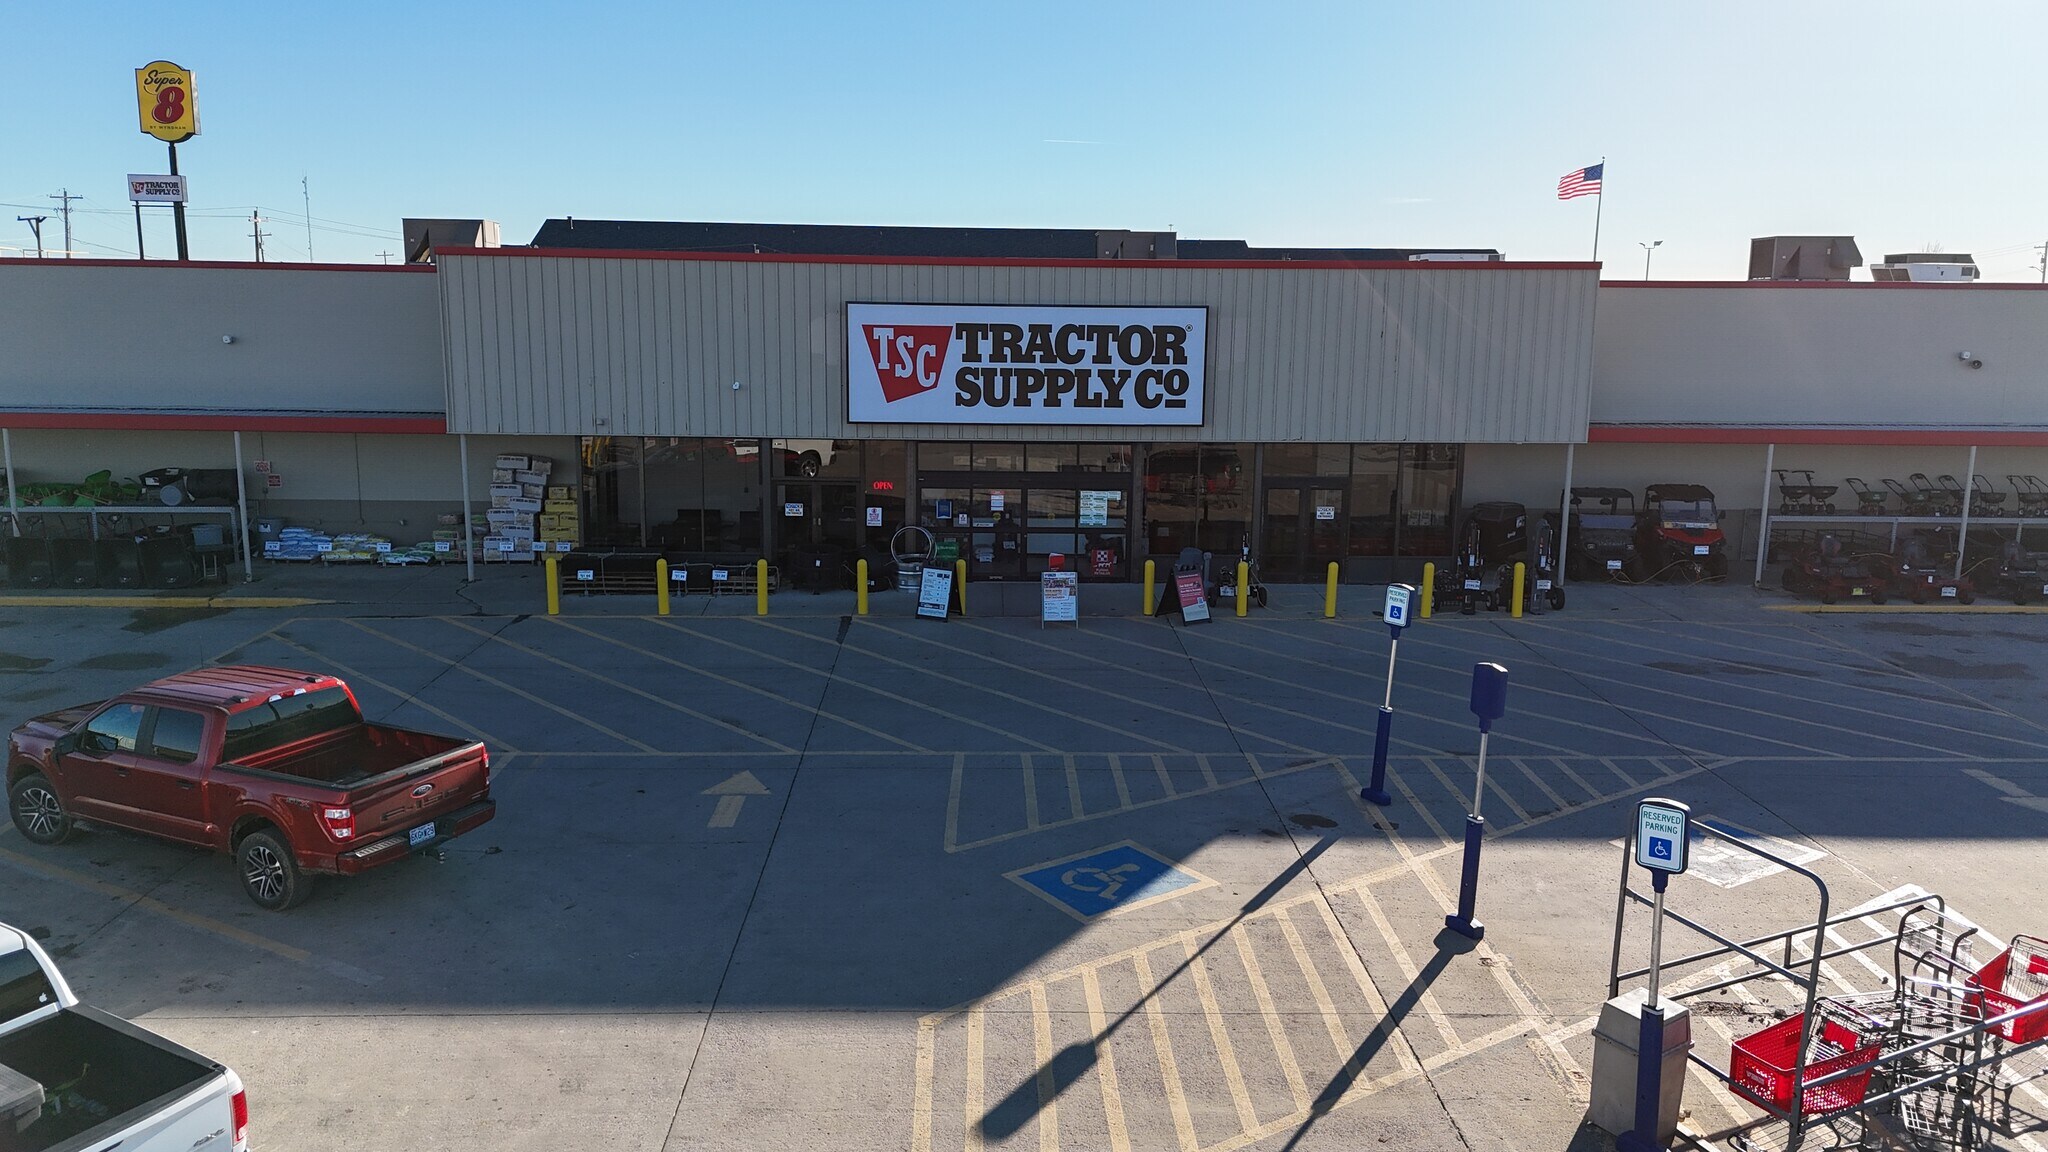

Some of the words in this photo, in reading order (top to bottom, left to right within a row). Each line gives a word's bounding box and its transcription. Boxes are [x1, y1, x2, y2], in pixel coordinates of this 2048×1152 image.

[144, 70, 183, 92] Super
[152, 86, 185, 124] 8
[955, 322, 1188, 366] TRACTOR
[872, 327, 937, 388] TSC
[955, 366, 1132, 409] SUPPLY
[873, 481, 893, 490] OPEN
[1389, 589, 1407, 598] RESERVED
[1389, 596, 1405, 604] PARKING
[1643, 811, 1681, 825] RESERVED
[1645, 822, 1678, 835] PARKING
